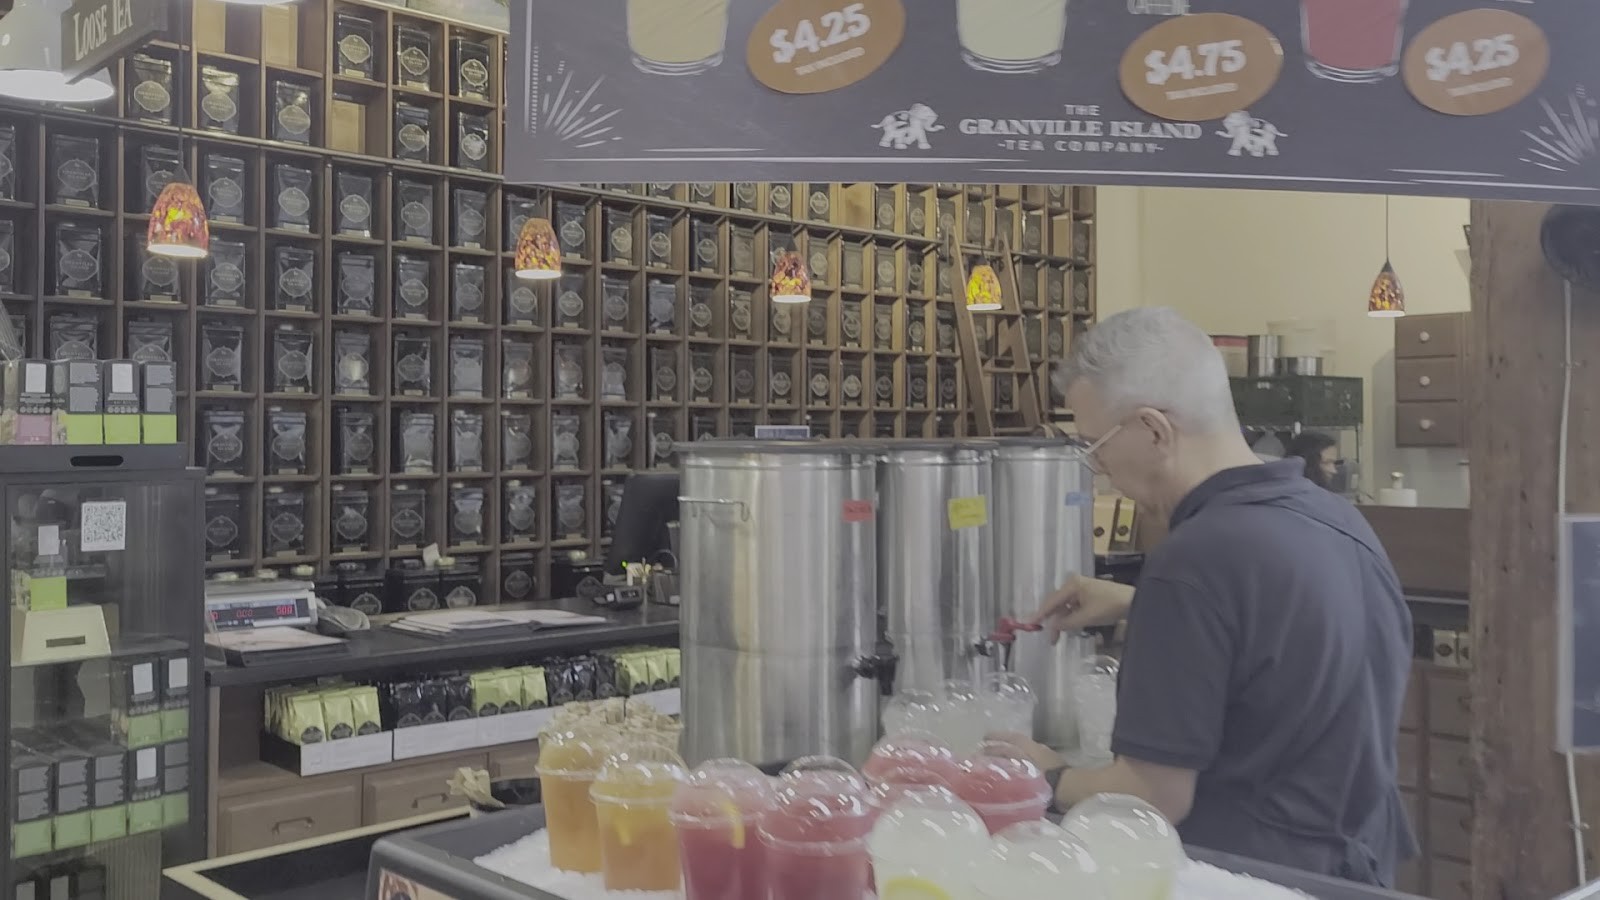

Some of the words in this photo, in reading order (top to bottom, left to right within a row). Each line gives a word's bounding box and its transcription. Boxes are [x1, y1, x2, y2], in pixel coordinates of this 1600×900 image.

[769, 3, 871, 63] $4.25
[1144, 40, 1247, 85] $4.75
[1424, 33, 1520, 81] $4.25
[958, 118, 1102, 137] GRANVILLE
[1109, 120, 1202, 140] ISLAND
[1063, 104, 1100, 116] THE
